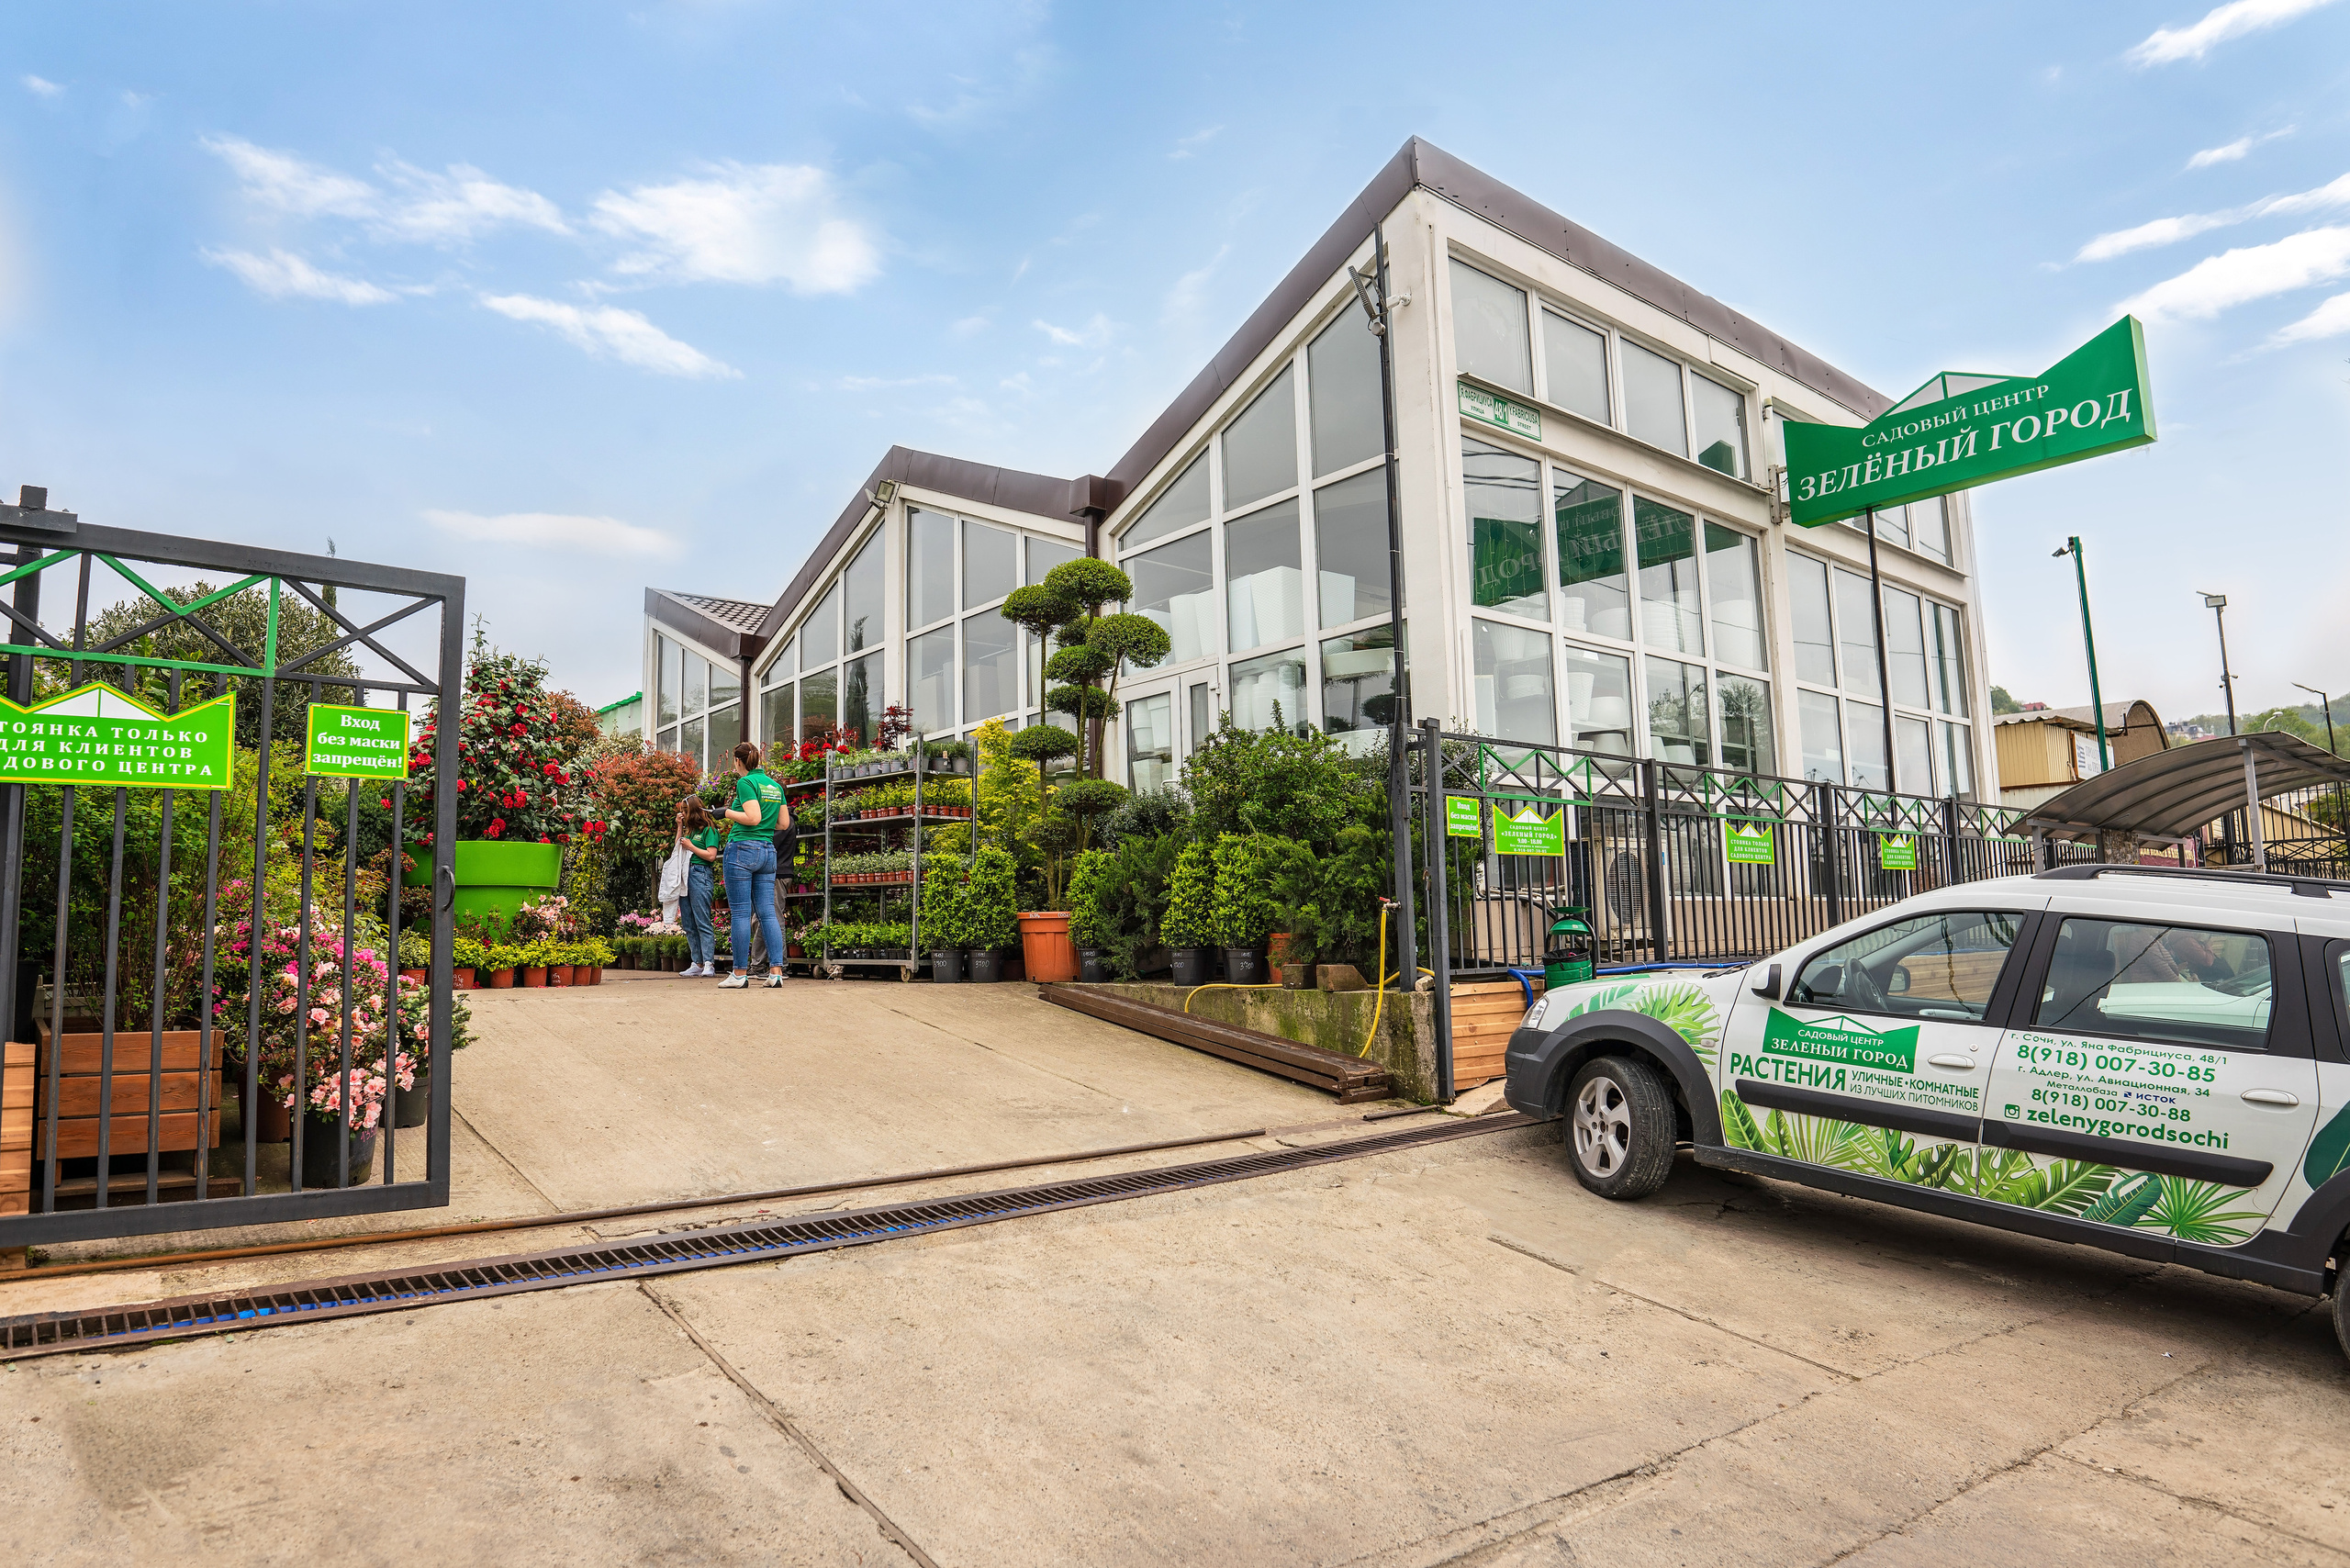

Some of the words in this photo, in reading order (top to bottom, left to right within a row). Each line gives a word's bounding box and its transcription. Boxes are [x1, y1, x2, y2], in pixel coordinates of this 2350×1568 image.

[1516, 421, 1532, 431] STREET
[1862, 406, 1968, 448] САДОВЫЙ
[1973, 384, 2050, 417] ЦЕНТР
[1797, 428, 1977, 502] ЗЕЛЁНЫЙ
[1988, 388, 2133, 452] ГОРОД
[111, 727, 207, 743] ТОЛЬКО
[340, 714, 380, 733] Вход
[59, 741, 193, 758] КЛИЕНТОВ
[317, 732, 351, 746] без
[351, 735, 400, 750] маски
[118, 761, 212, 776] ЦЕНТРА
[312, 751, 403, 768] запрещён!
[1797, 1029, 1849, 1042] САДОВЫЙ
[1851, 1035, 1885, 1047] ЦЕНТР
[2022, 1033, 2056, 1046] Сочи,
[2061, 1039, 2076, 1048] ул.
[2081, 1040, 2104, 1051] Яна
[2107, 1043, 2196, 1062] Фабрициуса,
[2199, 1055, 2227, 1065] 48/1
[1730, 1052, 1846, 1091] РАСТЕНИЯ
[1853, 1048, 1908, 1070] ГОРОД
[2017, 1044, 2088, 1070] 8(918)
[2095, 1055, 2216, 1082] 007-30-85
[1852, 1070, 1903, 1088] УЛИЧНЫЕ
[1909, 1080, 1979, 1099] КОМНАТНЫЕ
[2029, 1066, 2073, 1081] Адлер,
[2076, 1073, 2094, 1083] ул.
[2098, 1075, 2190, 1096] Авиационная,
[2195, 1087, 2210, 1097] 34
[2046, 1080, 2118, 1097] Металлобаза
[1850, 1083, 1863, 1094] ИЗ
[1863, 1086, 1906, 1101] ЛУЧШИХ
[1908, 1092, 1979, 1112] ПИТОМНИКОВ
[2031, 1088, 2089, 1111] 8(918)
[2095, 1097, 2190, 1122] 007-30-88
[2027, 1108, 2229, 1149] zelenygorodsochi
